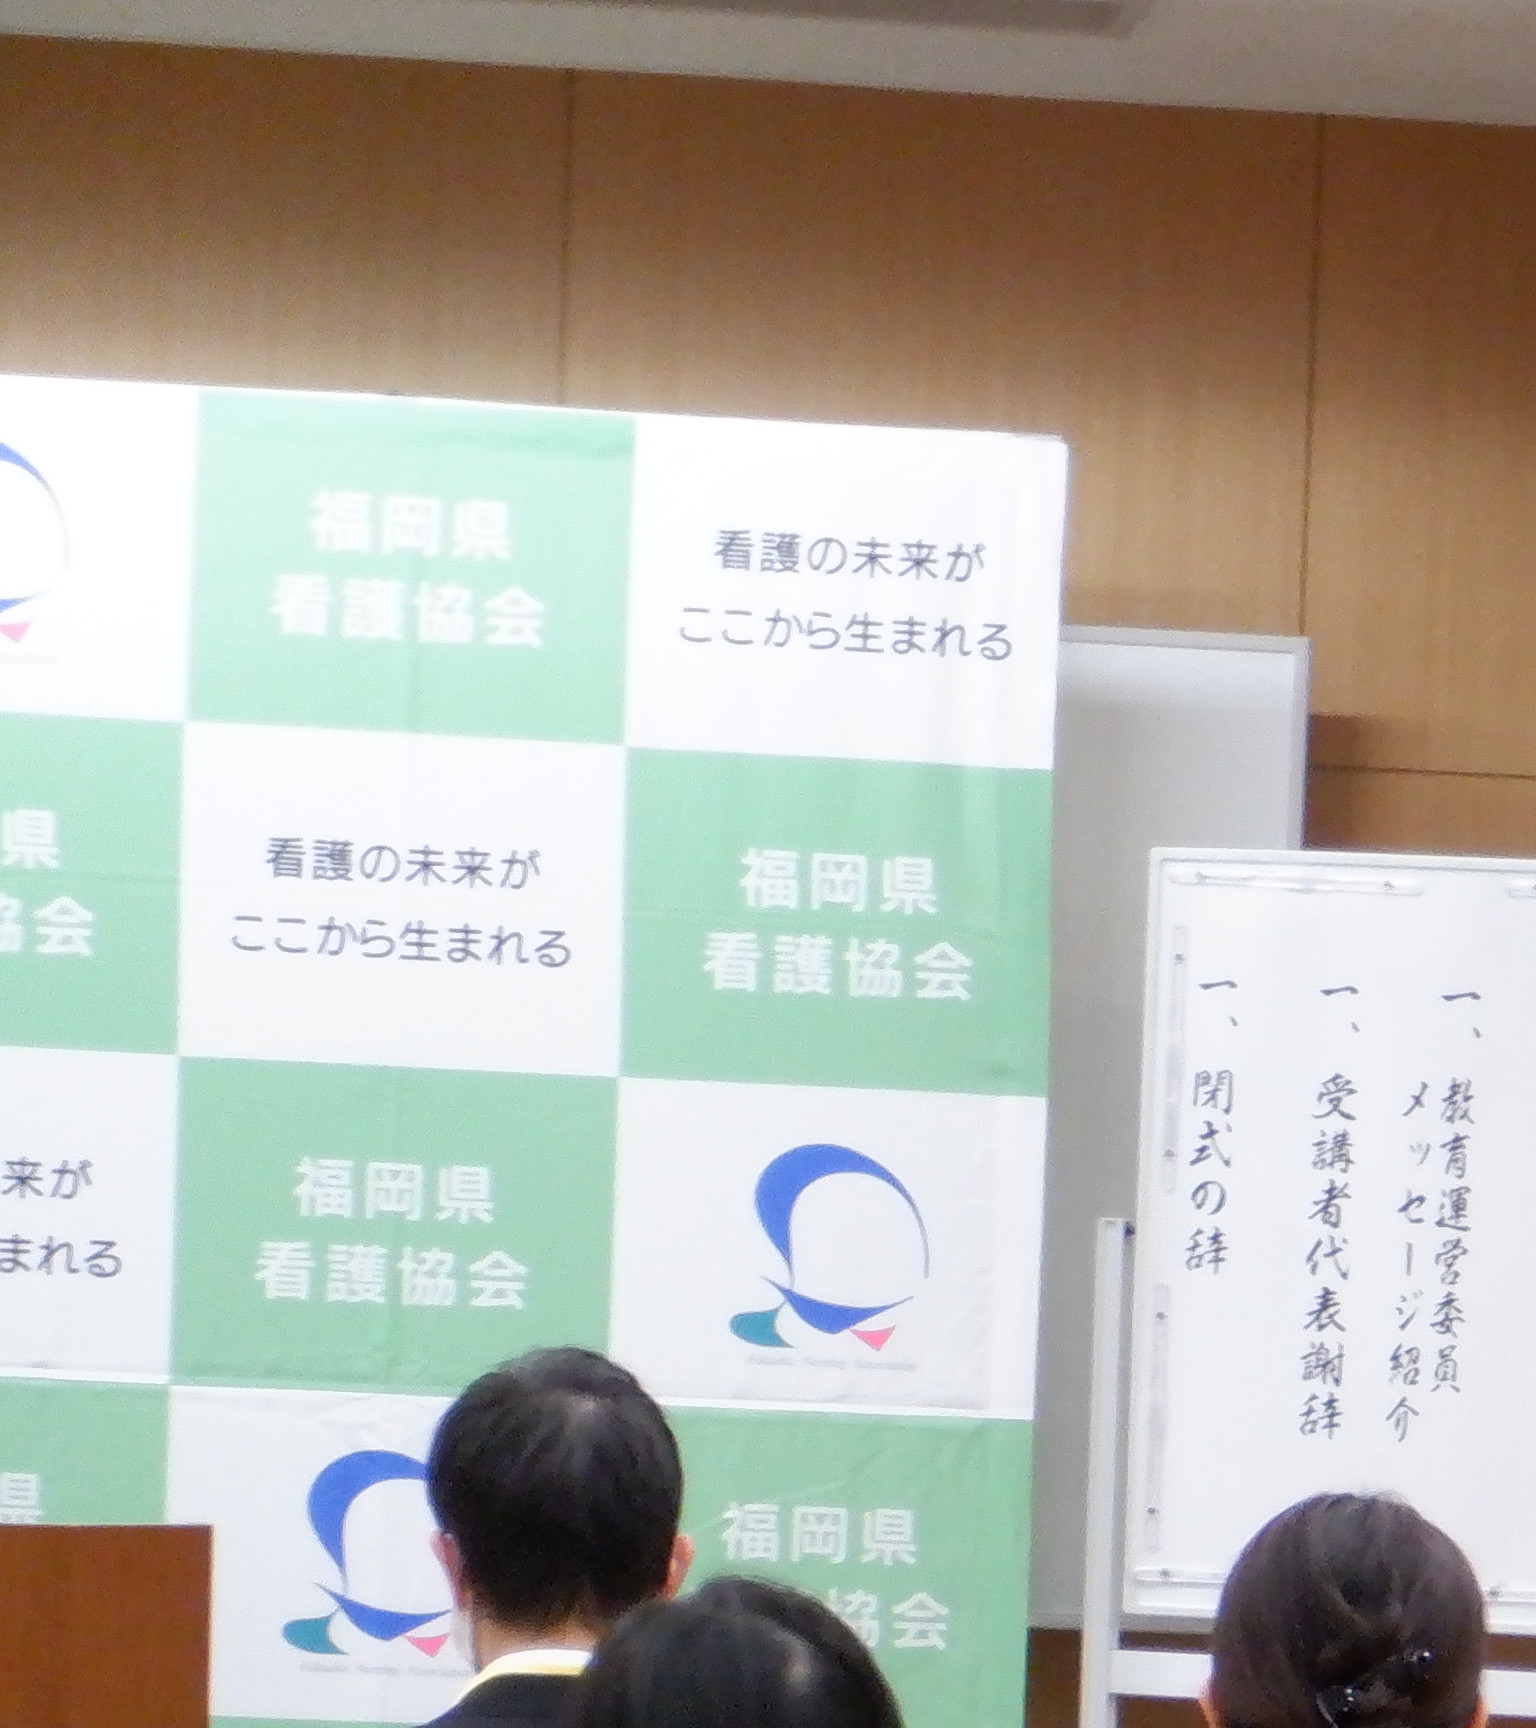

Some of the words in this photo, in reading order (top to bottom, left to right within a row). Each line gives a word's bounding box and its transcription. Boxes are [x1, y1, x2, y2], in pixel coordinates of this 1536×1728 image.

[310, 490, 512, 560] 福岡県
[714, 529, 986, 584] 看護の未来が
[270, 573, 546, 649] 看護協会
[679, 607, 1013, 662] ここから生まれる
[265, 836, 541, 891] 看護の未来が
[737, 846, 938, 916] 福岡県
[231, 914, 572, 969] ここから生まれる
[700, 930, 975, 1003] 看護協会
[291, 1155, 496, 1226] 福岡県
[253, 1239, 530, 1311] 看護協会
[1385, 1080, 1432, 1443] メッセージ紹介
[721, 1502, 917, 1566] 福岡県
